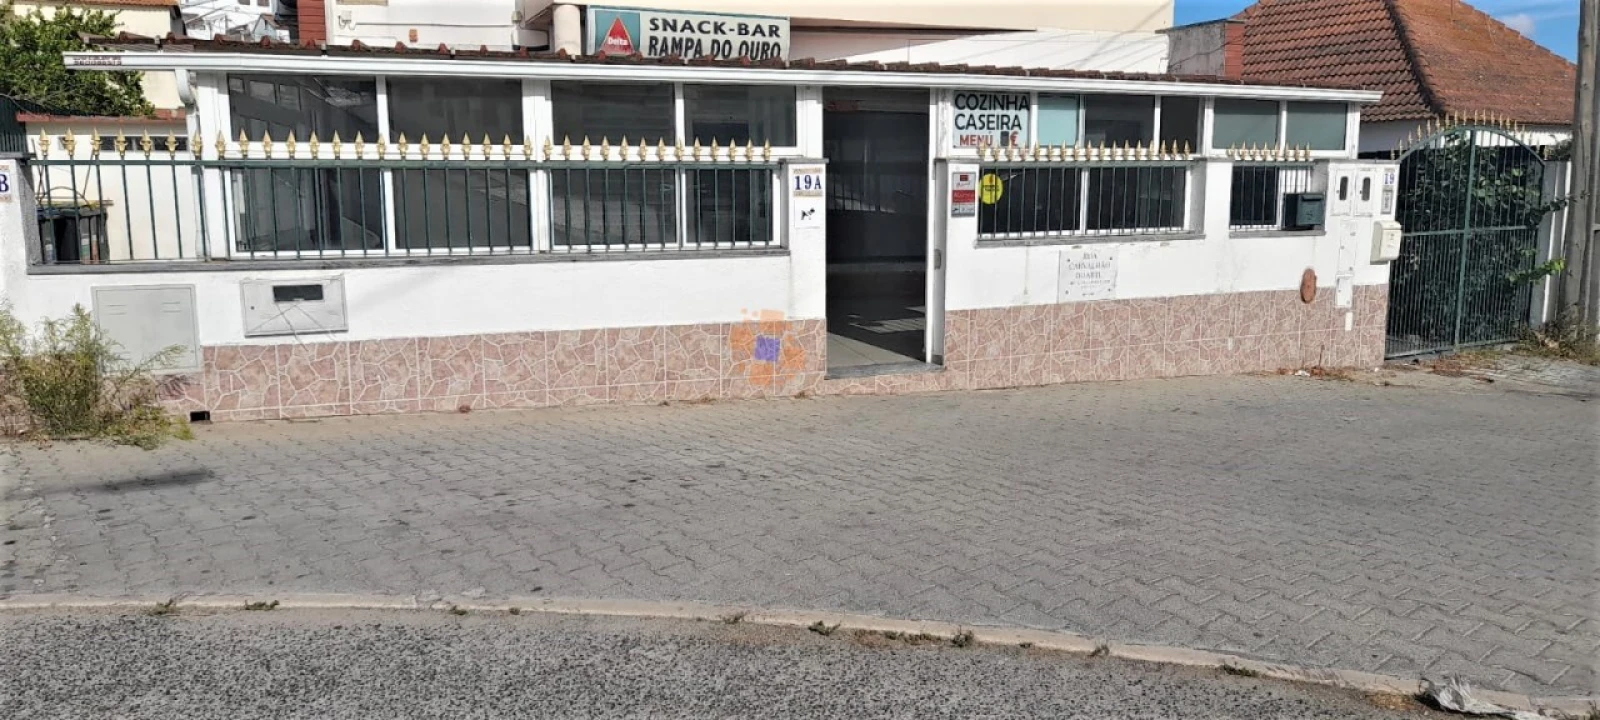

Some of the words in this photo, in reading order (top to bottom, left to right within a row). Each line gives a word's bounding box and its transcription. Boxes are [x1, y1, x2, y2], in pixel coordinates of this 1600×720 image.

[649, 17, 781, 38] SNACK-BAR
[648, 35, 703, 59] RAMPA
[710, 38, 732, 60] DO
[738, 39, 781, 61] OURO
[954, 93, 1030, 111] COZINHA
[954, 113, 1022, 131] CASEIRA
[794, 174, 822, 191] 19A
[1384, 172, 1396, 185] 19
